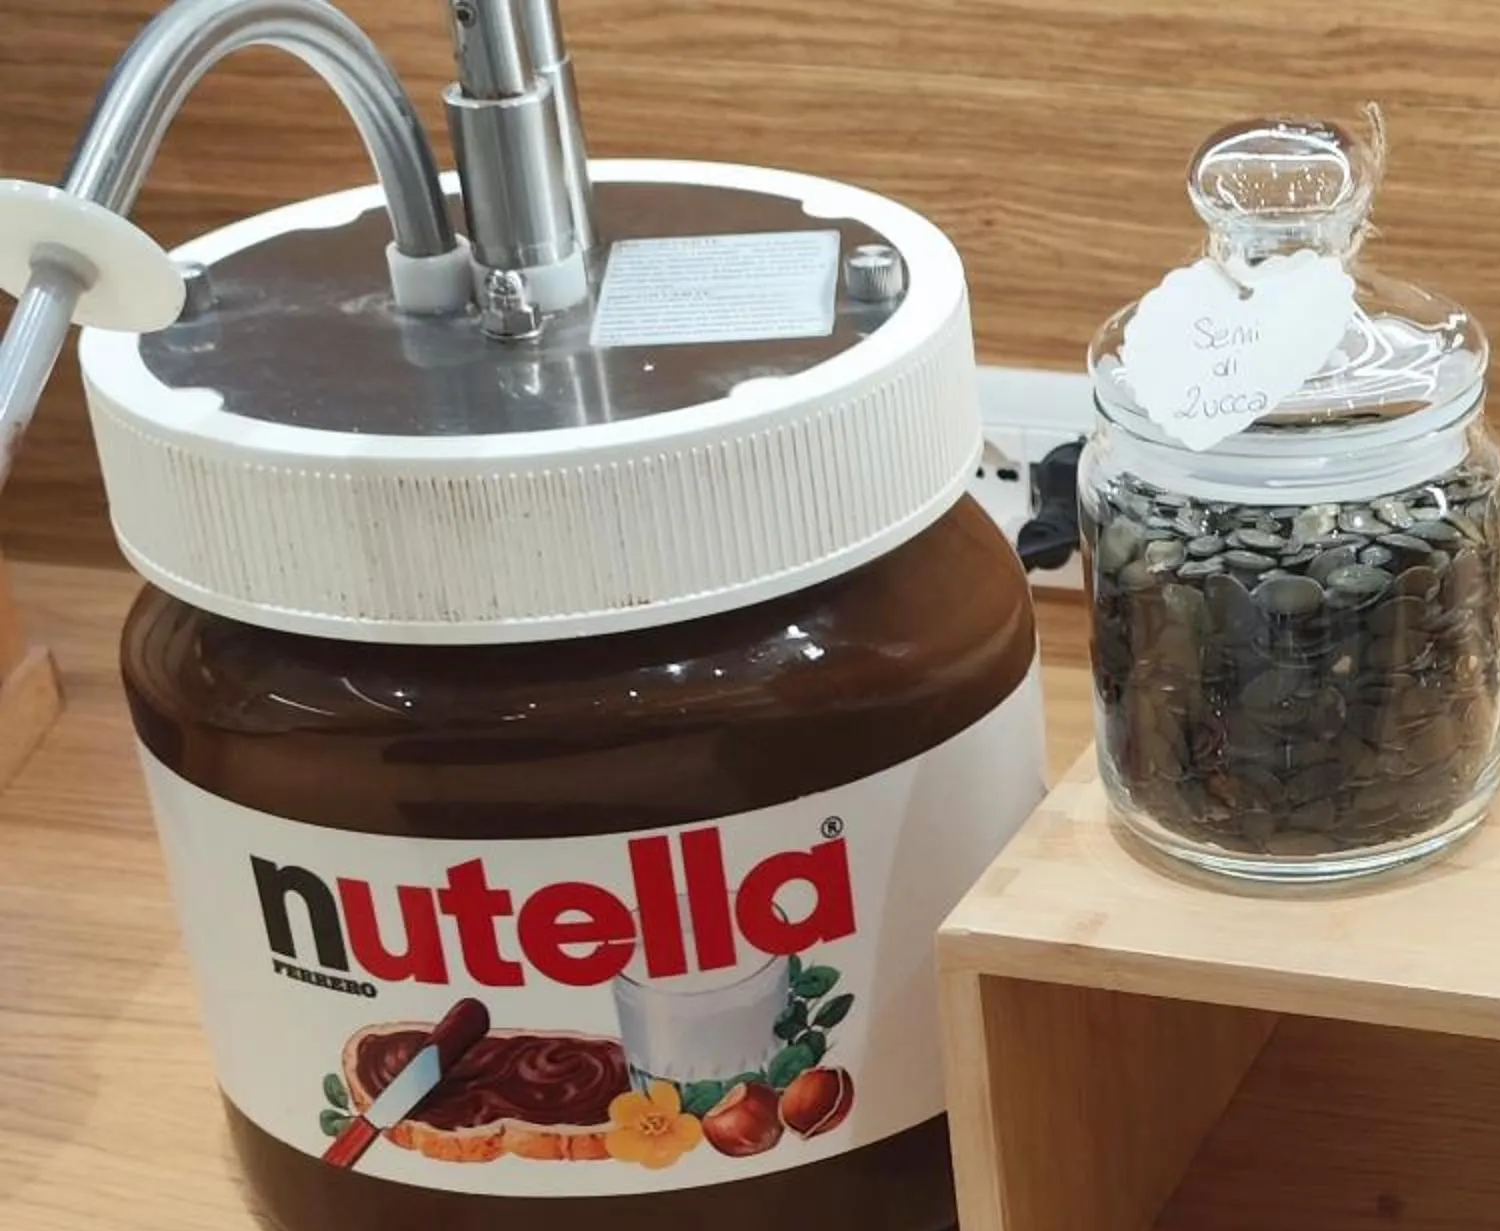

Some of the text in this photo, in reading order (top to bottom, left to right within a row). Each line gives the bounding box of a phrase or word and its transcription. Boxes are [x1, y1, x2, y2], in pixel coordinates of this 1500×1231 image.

[1194, 317, 1261, 350] Semi
[1212, 357, 1238, 377] di
[249, 827, 857, 987] nutella
[272, 957, 378, 998] FERRERO
